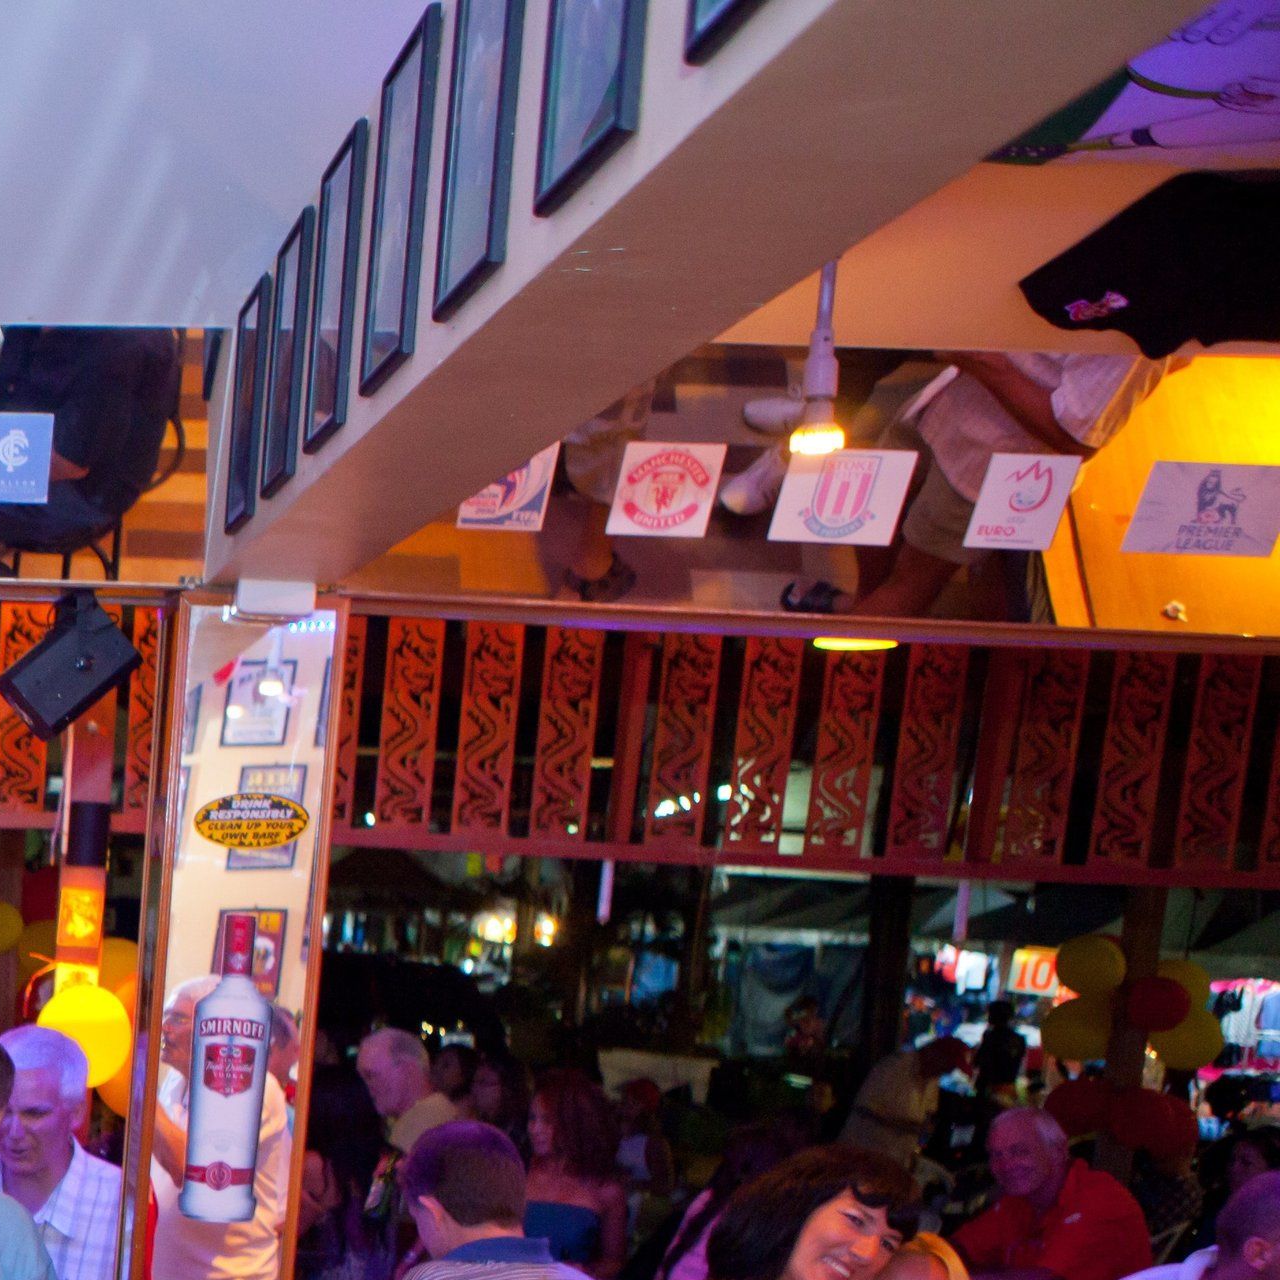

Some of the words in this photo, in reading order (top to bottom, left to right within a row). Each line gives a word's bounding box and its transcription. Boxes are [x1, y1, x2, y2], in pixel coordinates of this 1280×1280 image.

[1177, 525, 1242, 537] PREMIER
[1175, 538, 1235, 551] LEAGUE
[231, 800, 272, 809] DRINK
[209, 809, 294, 820] RESPONSIBLY
[208, 822, 242, 830] CLEAN
[246, 822, 262, 830] UP
[266, 821, 294, 830] YOUR
[221, 831, 249, 840] OWN
[200, 1018, 266, 1041] SMIRNOFF
